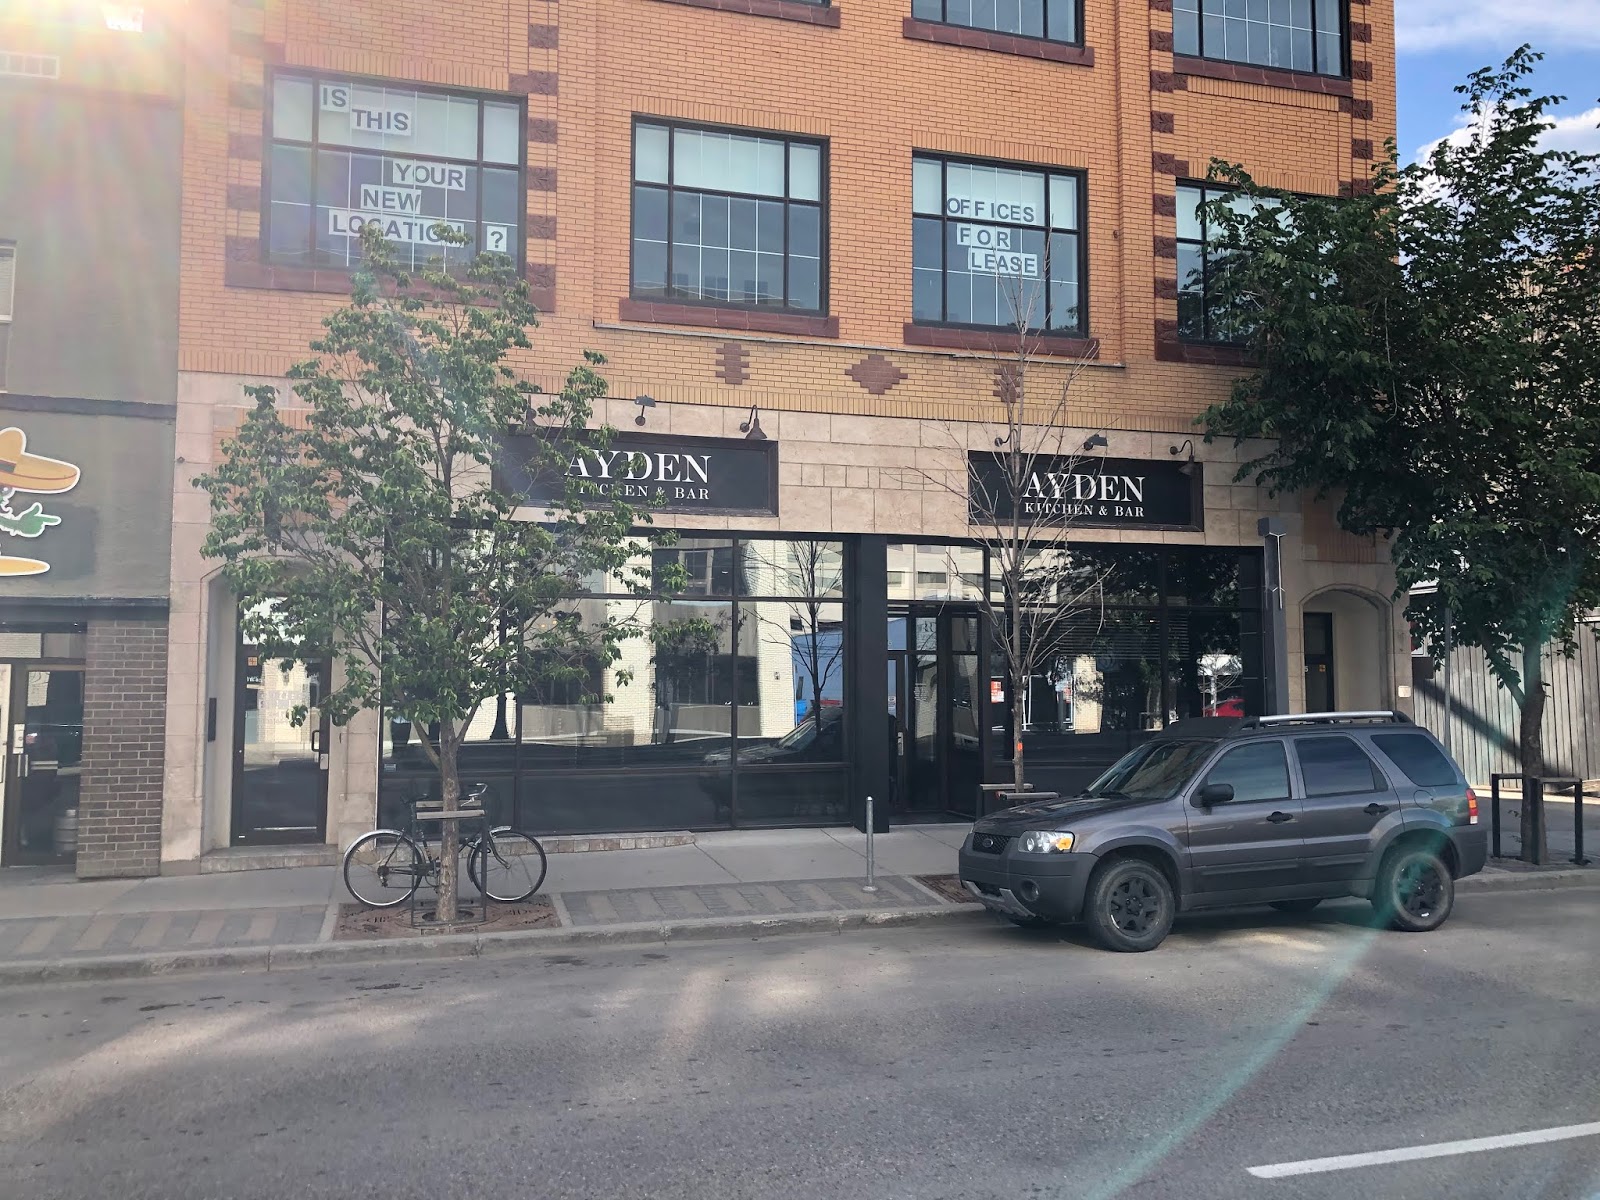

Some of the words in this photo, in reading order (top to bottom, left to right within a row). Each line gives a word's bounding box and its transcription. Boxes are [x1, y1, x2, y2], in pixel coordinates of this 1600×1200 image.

[322, 87, 347, 107] IS
[352, 108, 409, 131] THIS
[395, 162, 464, 188] YOUR
[363, 188, 421, 211] NEW
[947, 197, 1035, 223] OFFICES
[490, 230, 504, 248] ?
[960, 227, 1010, 248] FOR
[971, 252, 1036, 274] LEASE
[564, 449, 712, 484] AYDEN
[567, 481, 649, 497] ICEN
[674, 486, 710, 500] BAR
[1022, 471, 1146, 503] AYDEN
[1025, 502, 1094, 516] KITCHEN
[1099, 505, 1108, 516] &
[1115, 505, 1145, 518] BAR
